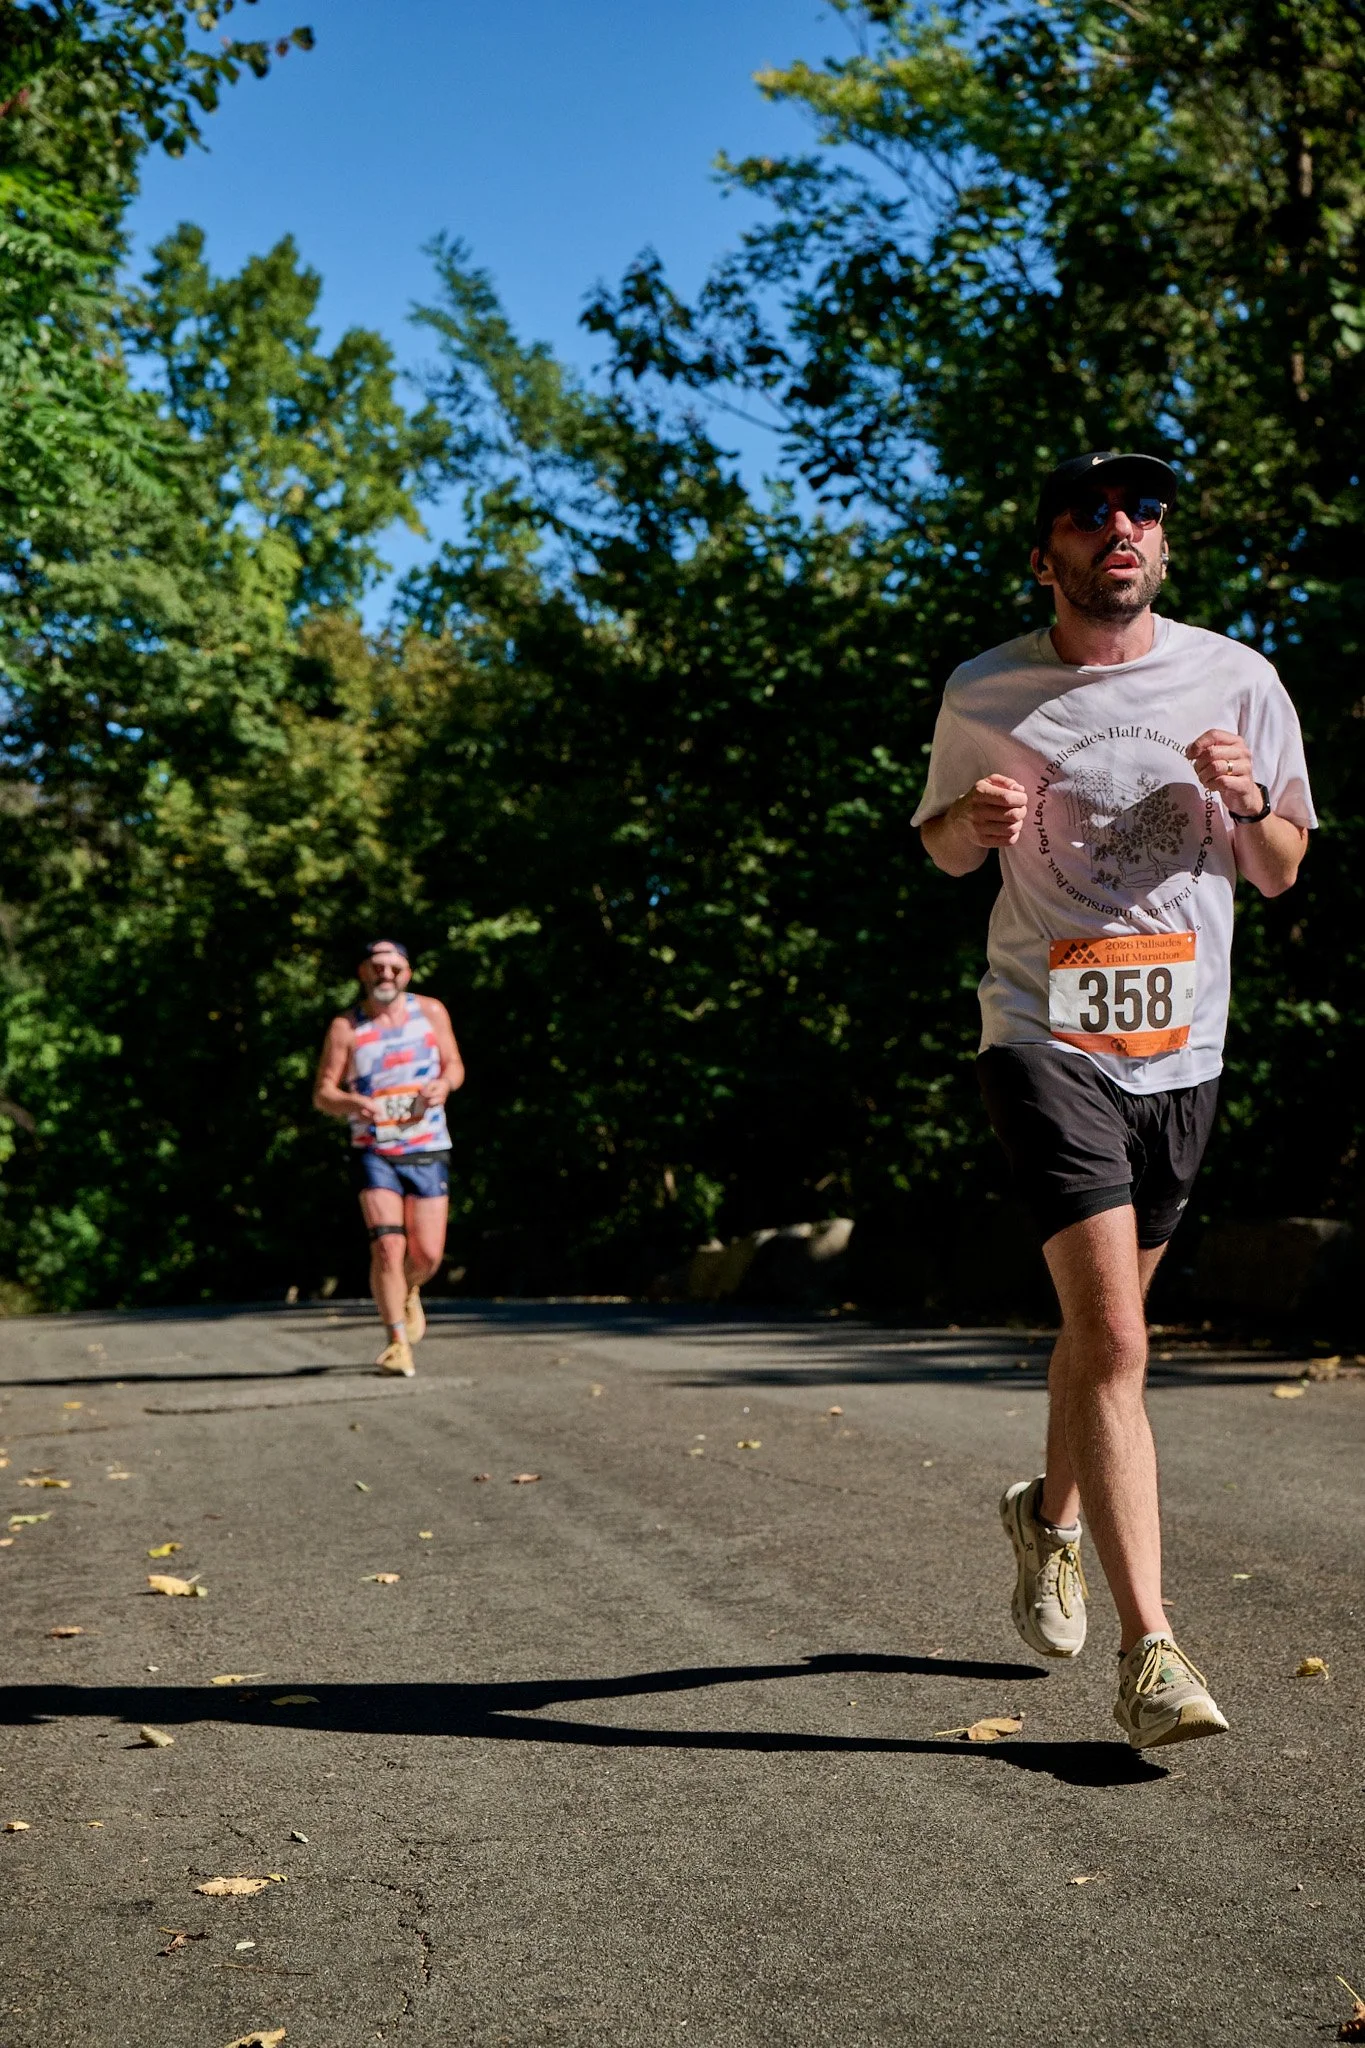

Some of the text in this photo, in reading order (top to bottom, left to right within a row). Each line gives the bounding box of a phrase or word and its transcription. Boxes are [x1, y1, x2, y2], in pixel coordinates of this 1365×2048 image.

[1046, 726, 1188, 775] Palisades Half Marat
[1036, 776, 1050, 797] NJ
[1204, 788, 1215, 834] ctober
[1037, 827, 1050, 855] Fort
[1047, 857, 1068, 888] Park
[1066, 886, 1132, 920] Interstate
[1105, 938, 1182, 951] 2026 Palisades
[1106, 952, 1180, 963] Half Marathon
[1079, 967, 1173, 1033] 358
